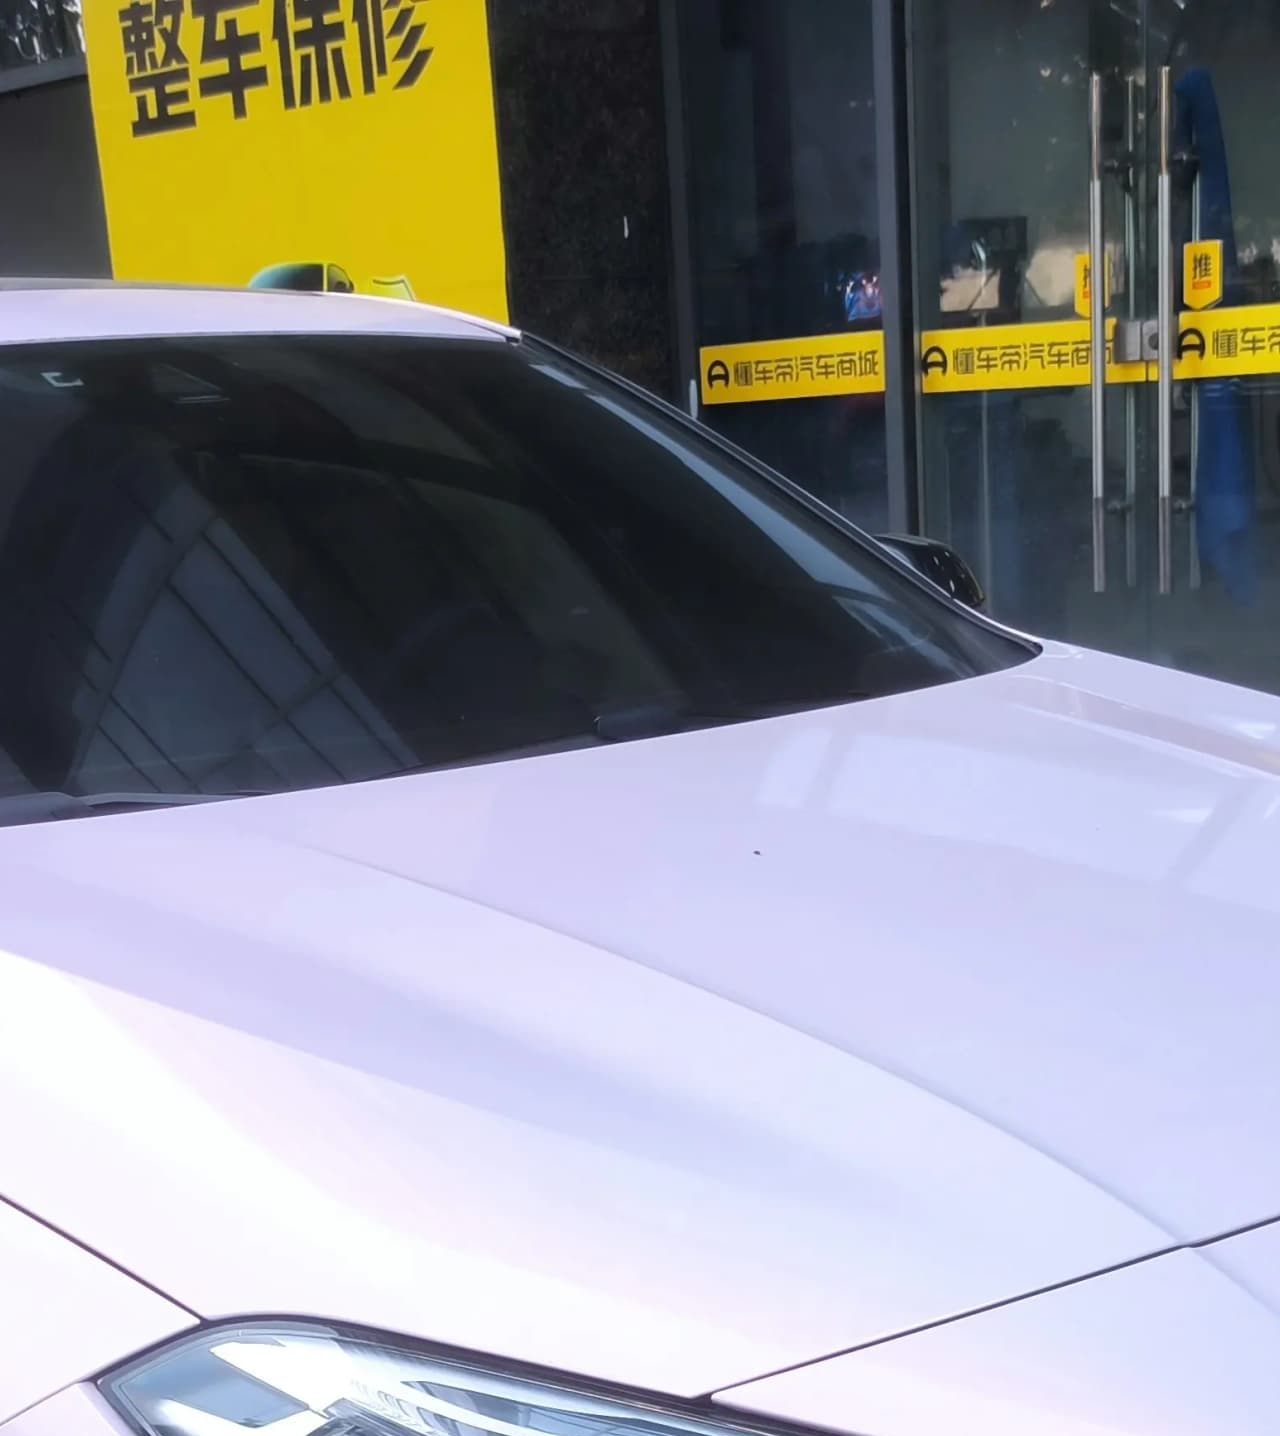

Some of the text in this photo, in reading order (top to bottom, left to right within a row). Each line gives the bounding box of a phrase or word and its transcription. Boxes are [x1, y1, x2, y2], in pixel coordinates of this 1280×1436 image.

[118, 0, 434, 138] 整车保修
[1192, 253, 1212, 279] 推
[733, 350, 878, 387] 懂车帝汽车商城
